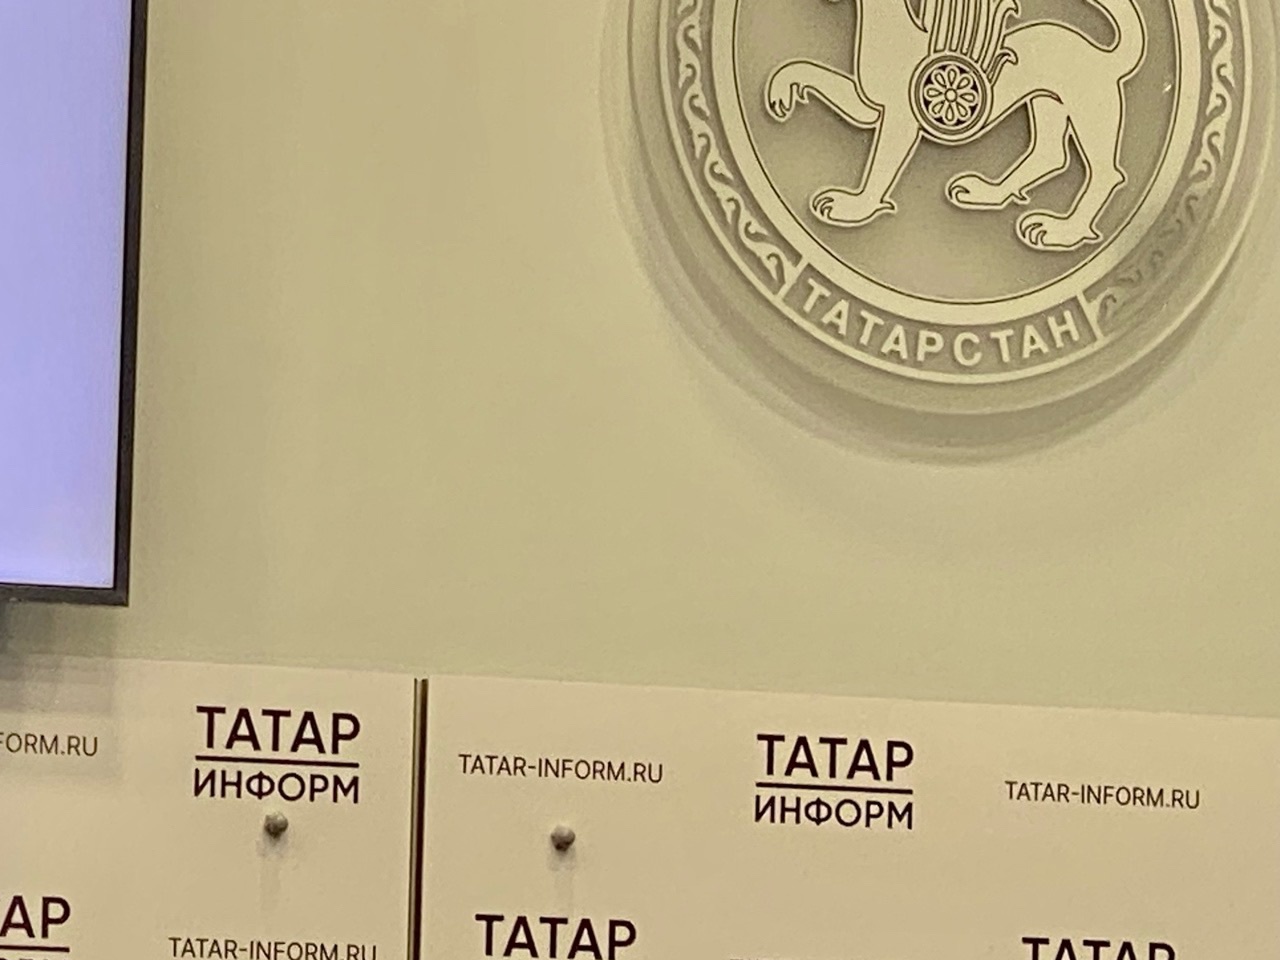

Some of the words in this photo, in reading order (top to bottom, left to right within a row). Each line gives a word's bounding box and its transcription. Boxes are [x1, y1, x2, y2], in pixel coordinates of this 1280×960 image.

[800, 277, 1081, 367] ТАТАРСТАН
[194, 705, 361, 755] ТАТАР
[458, 753, 663, 784] TATAR-INFORM.RU
[755, 733, 914, 781] ТАТАР
[193, 768, 360, 804] ИНФОРМ
[1004, 780, 1200, 810] TATAR-INFORM.RU
[754, 795, 914, 830] ИНФОРМ
[474, 913, 637, 960] ТАТАР
